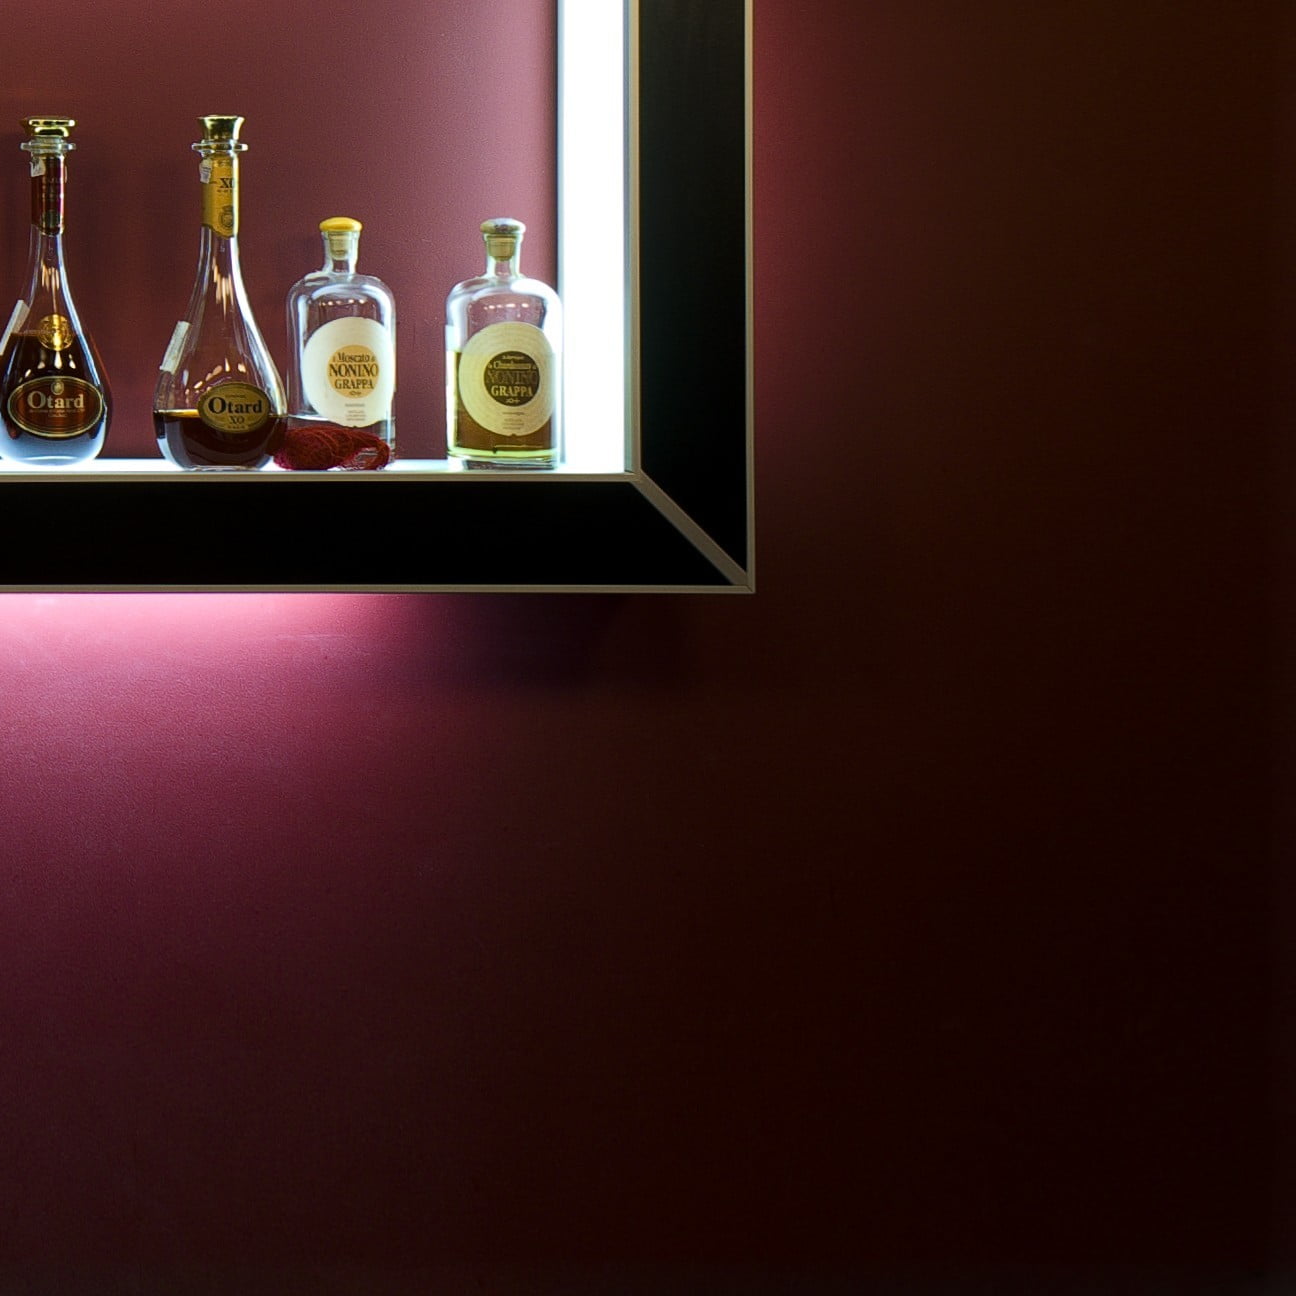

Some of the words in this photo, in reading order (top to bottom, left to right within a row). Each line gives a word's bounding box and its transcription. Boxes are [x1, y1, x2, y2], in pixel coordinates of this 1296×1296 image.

[337, 352, 370, 363] Moscato
[329, 363, 379, 377] NONINO
[334, 378, 375, 390] GRAPPA
[491, 385, 533, 397] GRAPPA
[27, 390, 85, 409] Otard
[208, 396, 263, 415] Otard
[229, 415, 245, 425] XO
